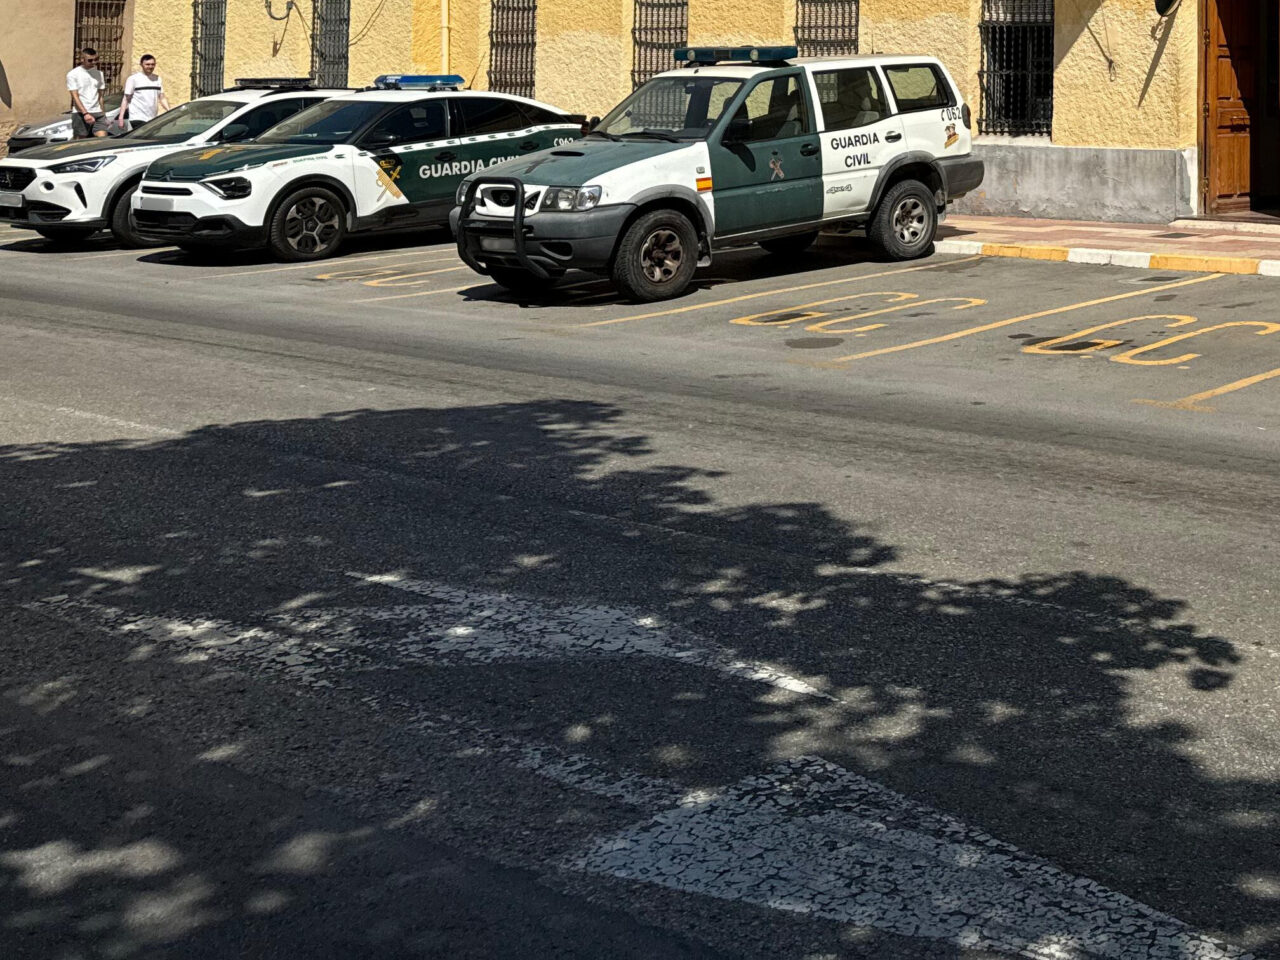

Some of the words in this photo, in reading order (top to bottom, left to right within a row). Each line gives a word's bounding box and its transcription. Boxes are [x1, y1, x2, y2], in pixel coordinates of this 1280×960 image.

[946, 106, 962, 121] 062
[830, 132, 880, 150] GUARDIA
[844, 153, 871, 167] CIVIL
[419, 158, 485, 179] GUARDIA
